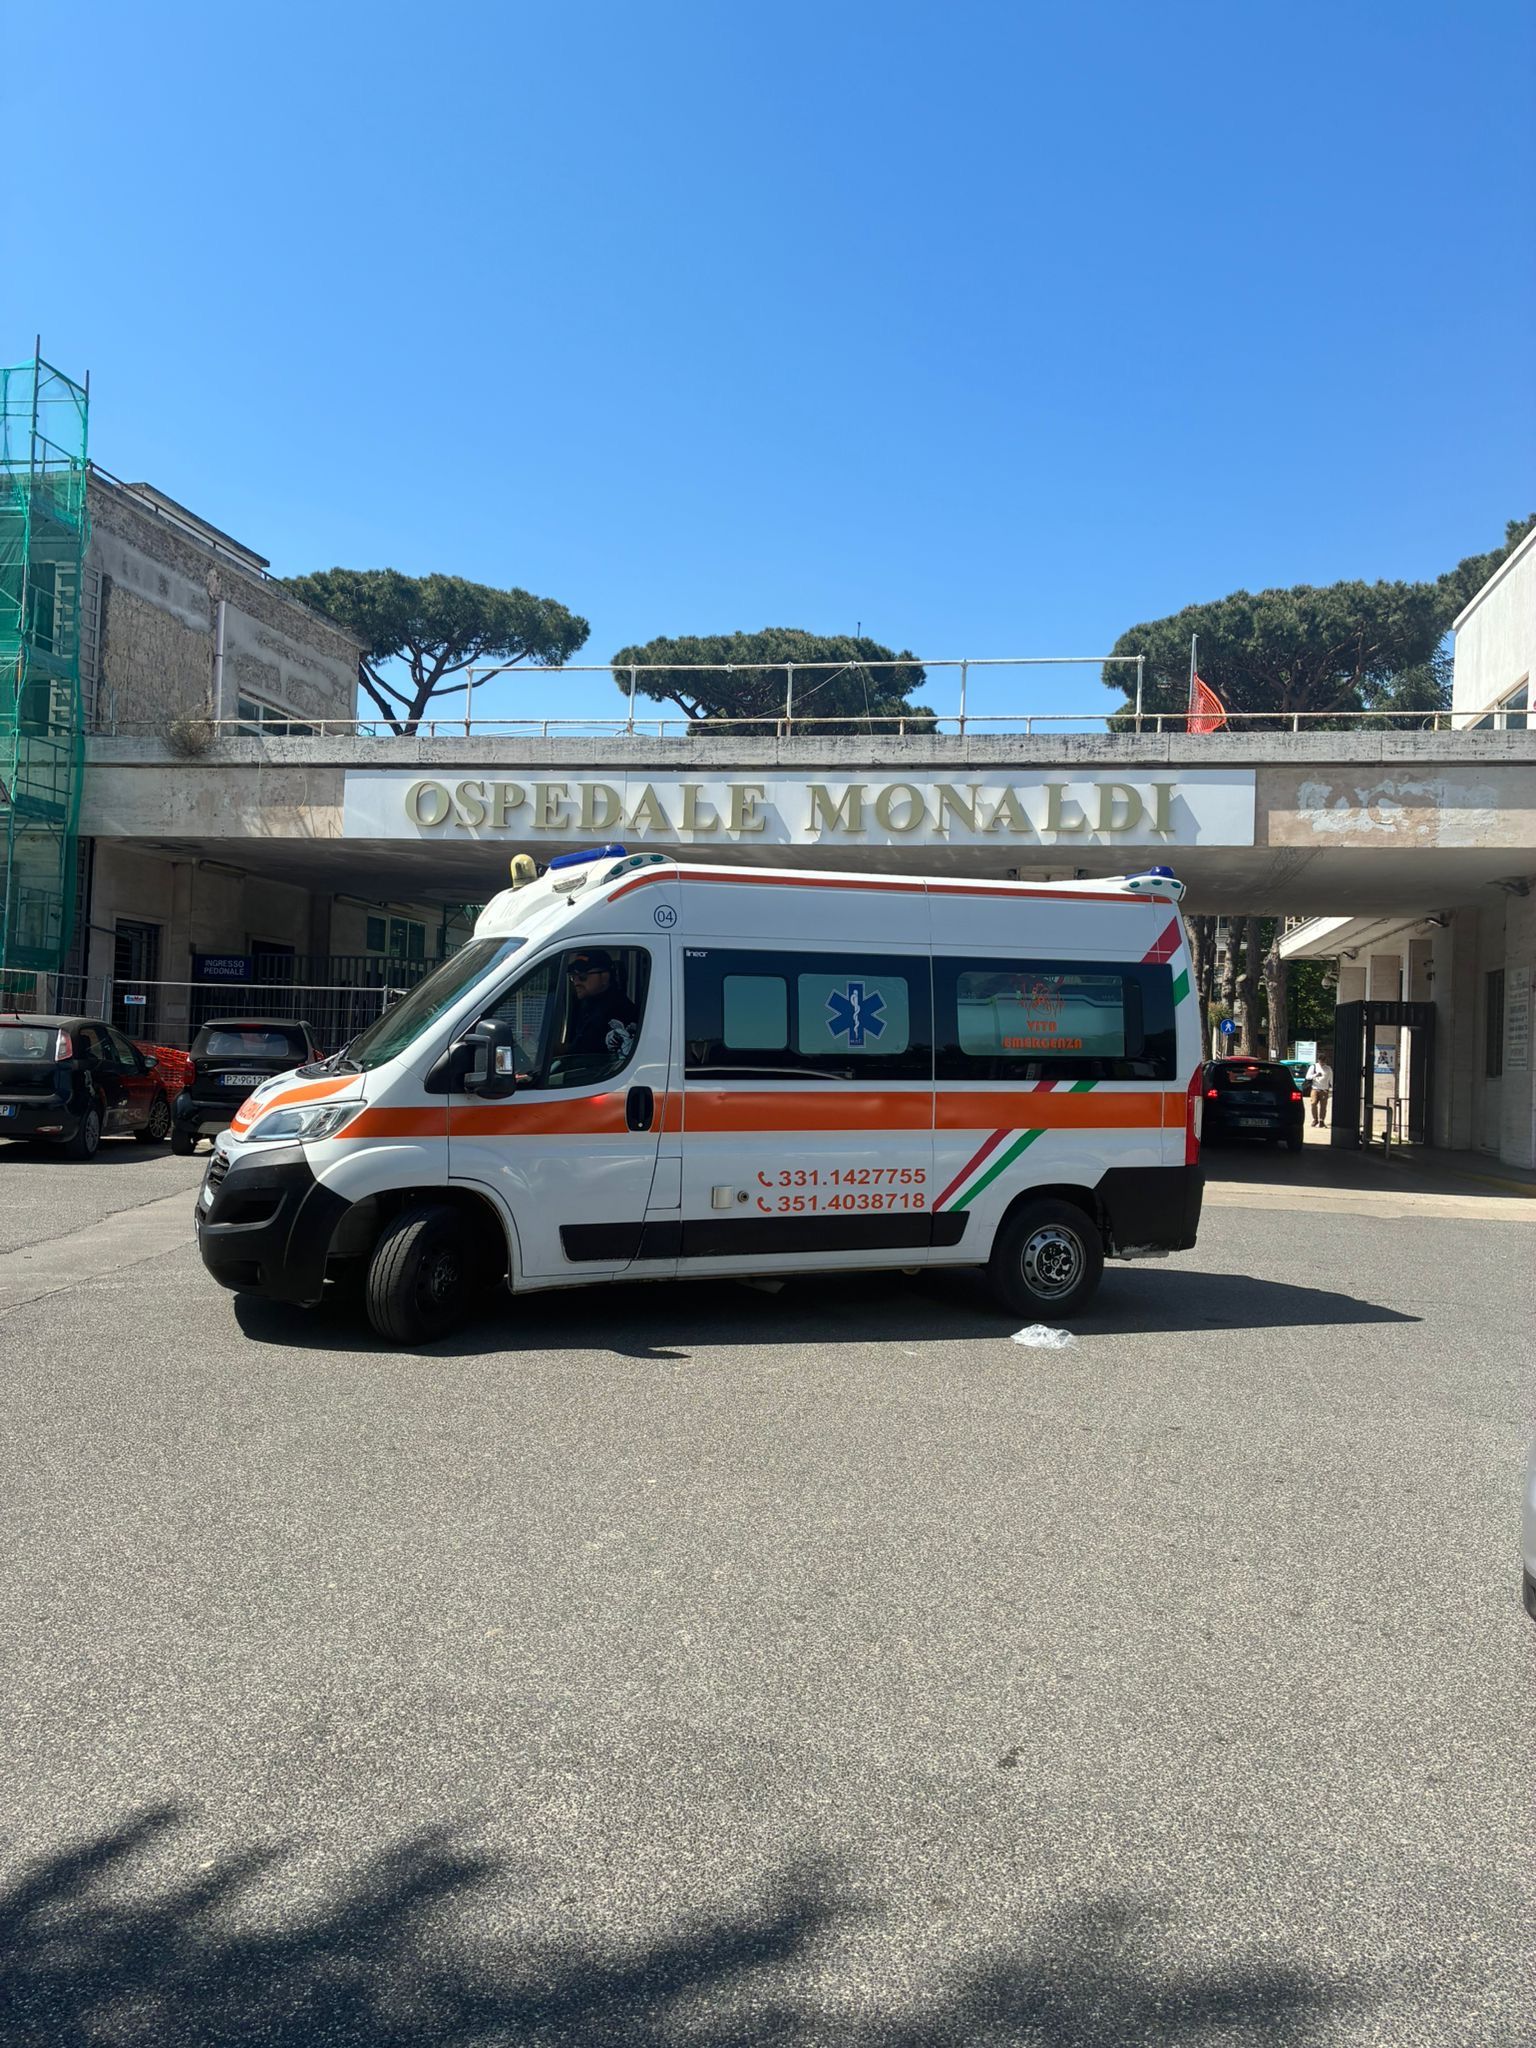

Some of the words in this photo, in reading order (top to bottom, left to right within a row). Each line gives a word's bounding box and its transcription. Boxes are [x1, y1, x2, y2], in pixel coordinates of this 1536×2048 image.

[404, 781, 767, 832] OSPEDALE
[804, 782, 1178, 833] MONALDI
[657, 910, 674, 923] 04
[204, 967, 245, 976] PEDONALE
[205, 960, 245, 968] INGRESSO
[778, 1168, 927, 1187] 331.1427755
[777, 1193, 926, 1212] 351.4038718
